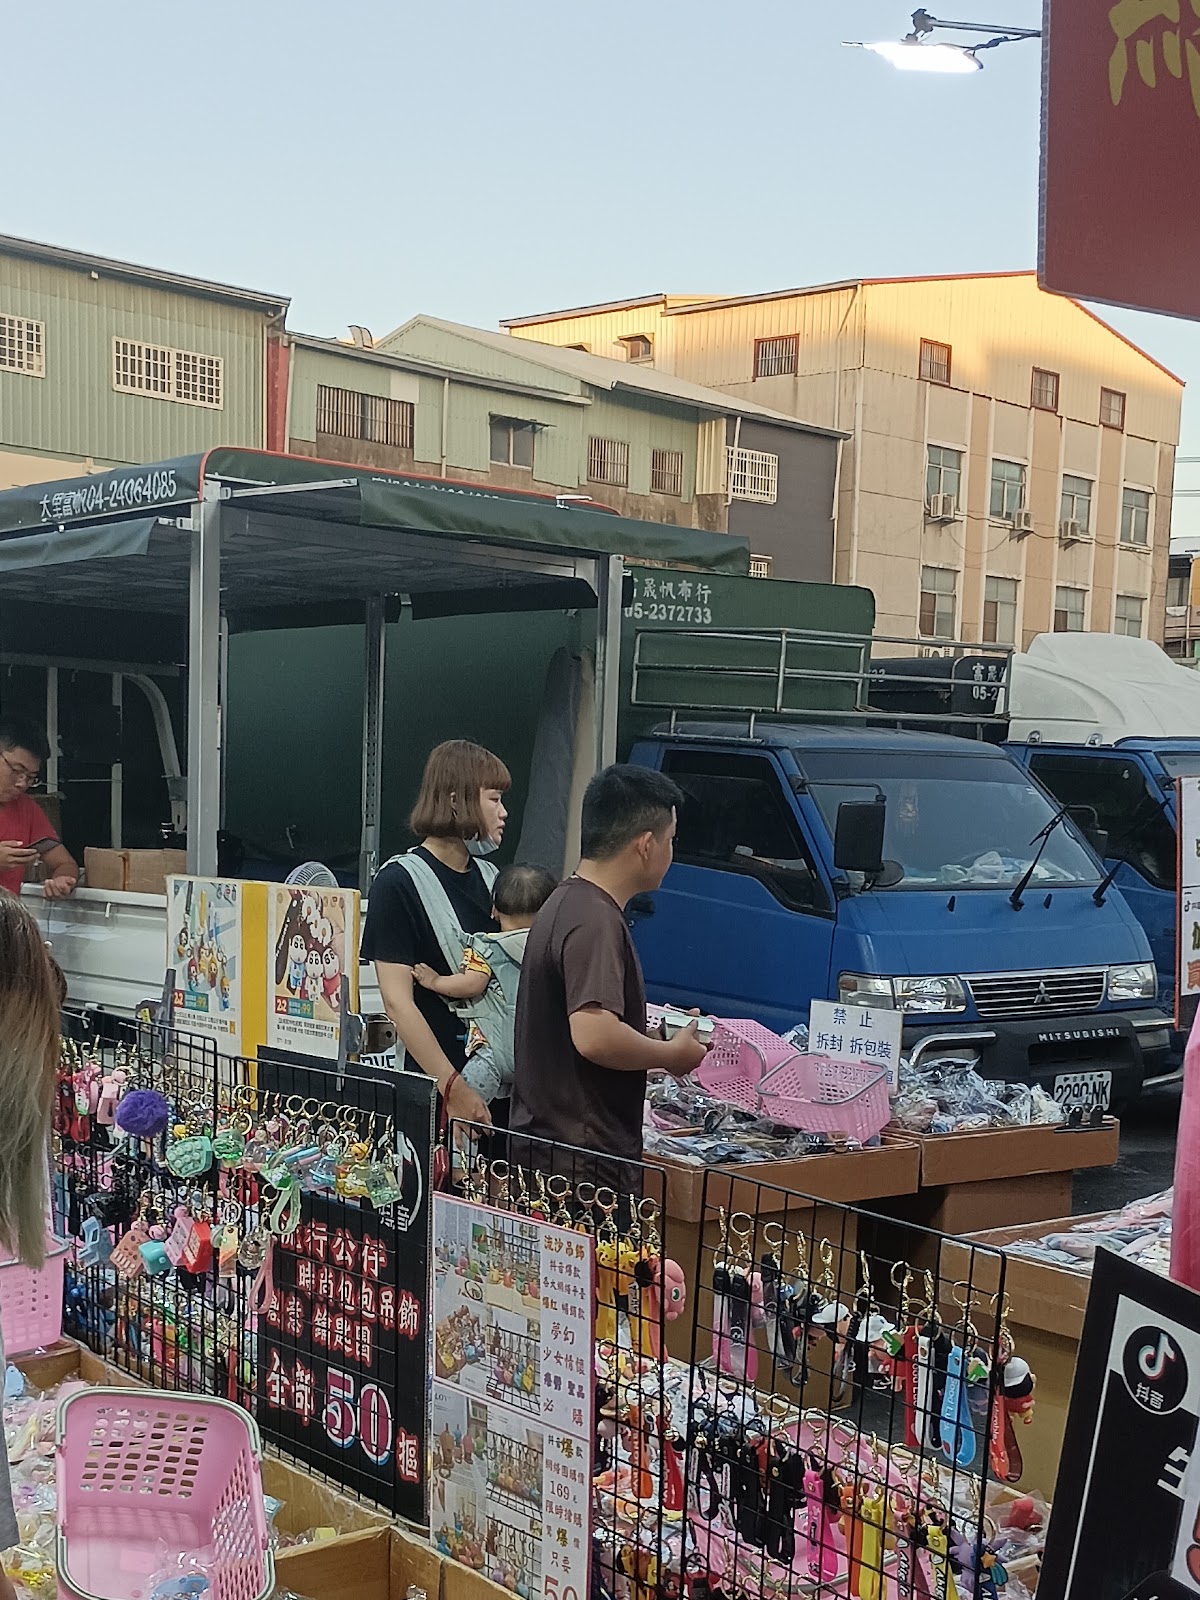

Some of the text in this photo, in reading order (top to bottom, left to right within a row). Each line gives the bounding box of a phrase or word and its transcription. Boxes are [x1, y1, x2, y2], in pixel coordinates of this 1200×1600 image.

[633, 577, 712, 604] 晟帆布行
[624, 602, 712, 625] 05-2372733
[816, 1032, 892, 1059] 拆封 拆包裝
[1038, 1027, 1121, 1043] MITSUBISHI
[551, 1321, 575, 1345] 夢幻
[543, 1346, 585, 1375] 少女情懷
[1135, 1382, 1164, 1410] 抖音
[322, 1366, 393, 1466] 50
[550, 1480, 570, 1500] 169
[550, 1551, 571, 1574] 只要
